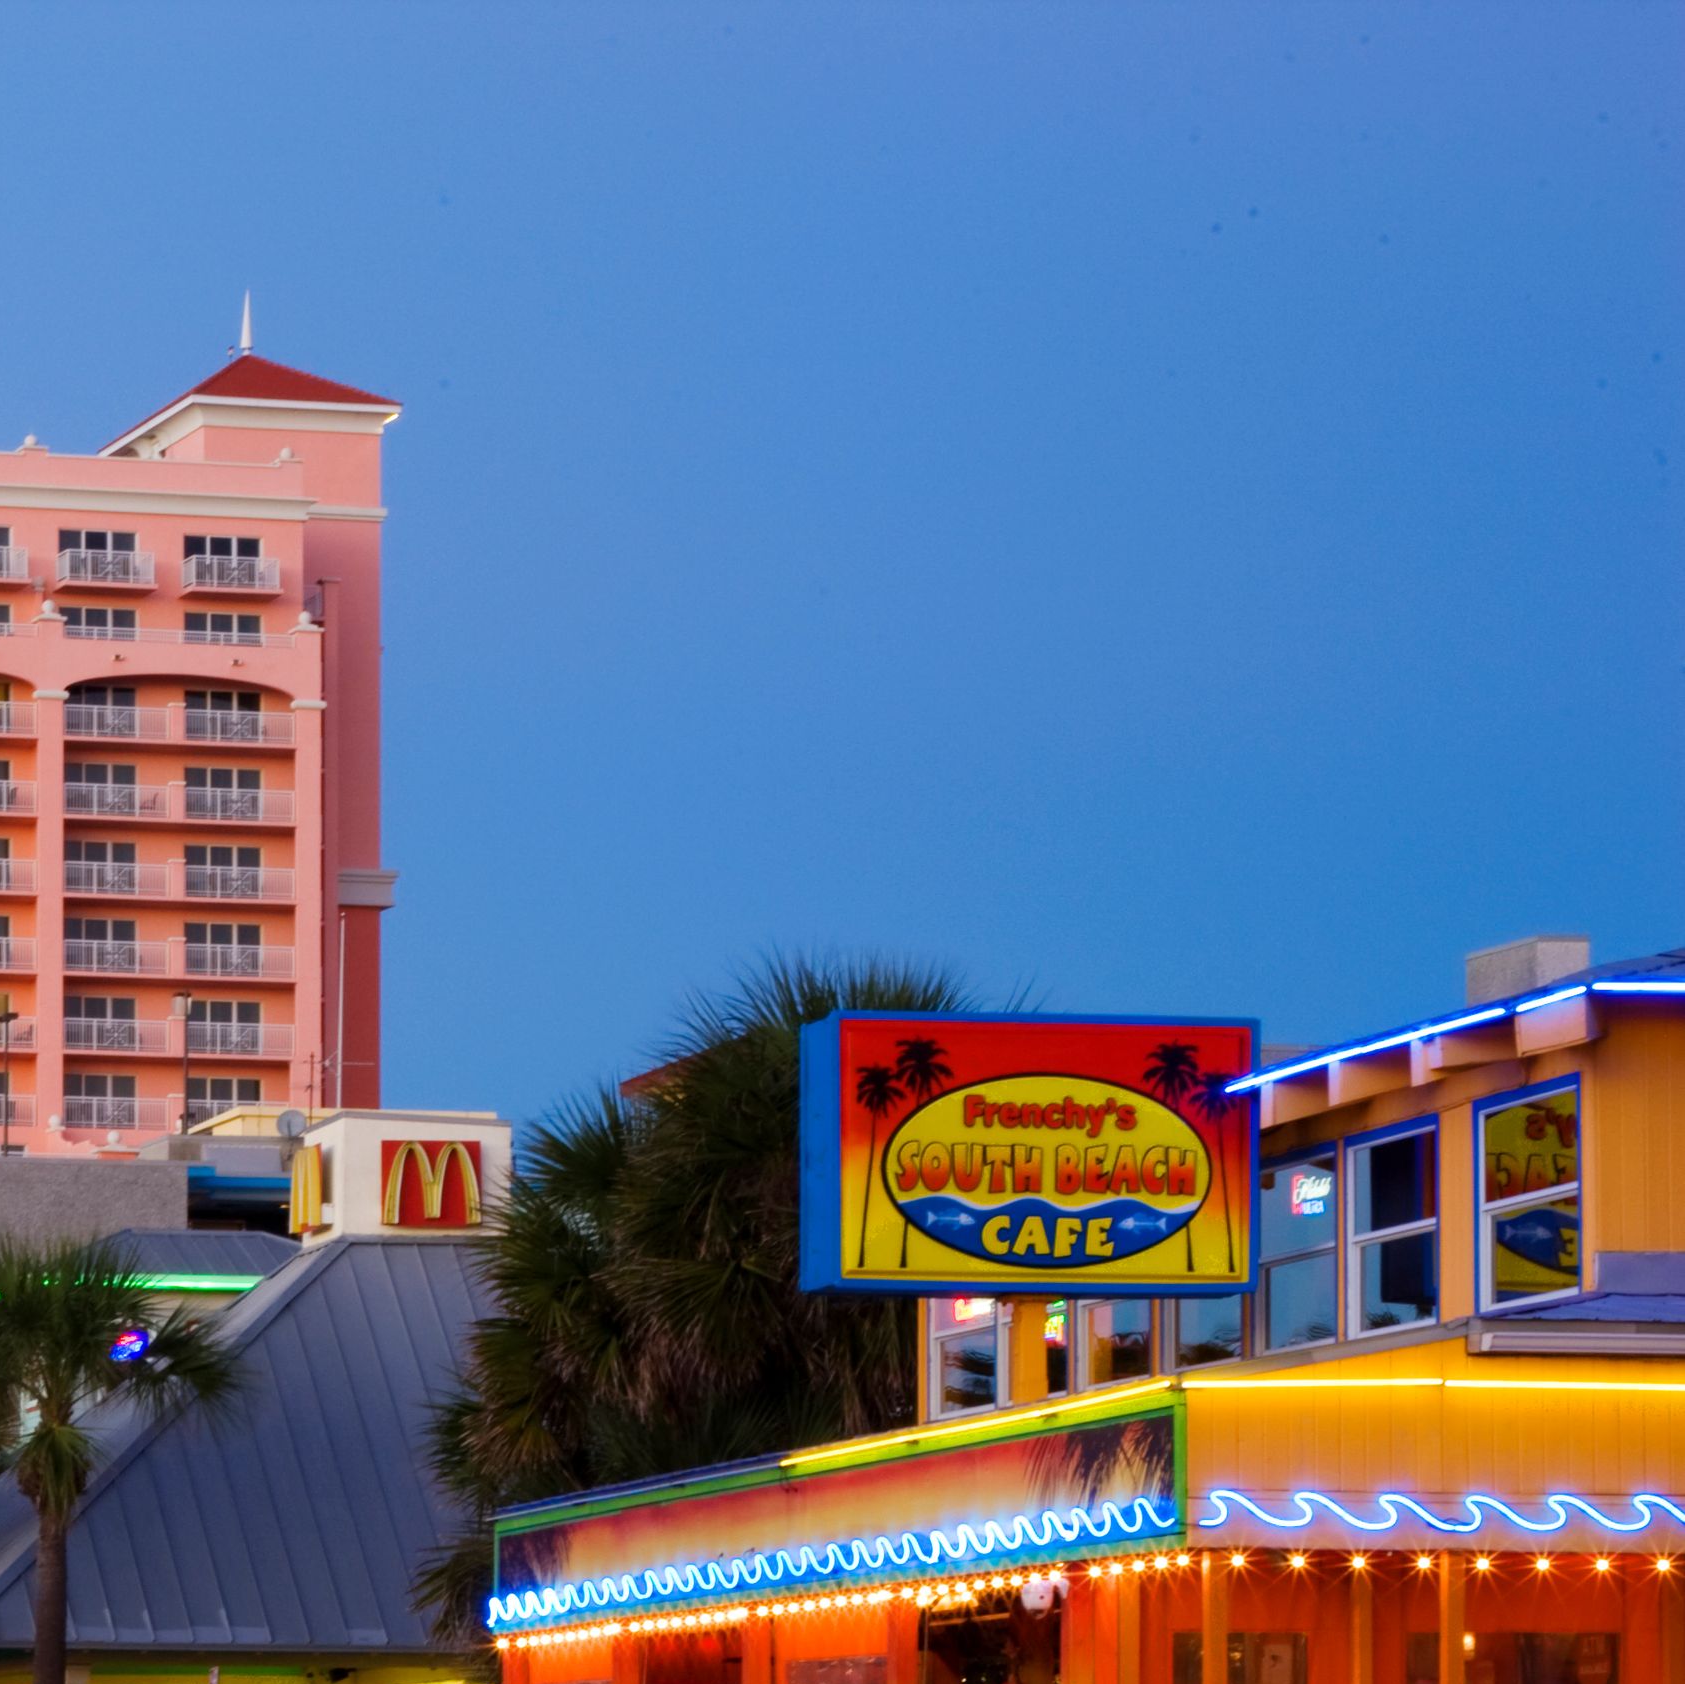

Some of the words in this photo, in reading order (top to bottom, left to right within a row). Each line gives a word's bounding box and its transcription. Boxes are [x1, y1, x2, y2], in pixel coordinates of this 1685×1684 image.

[962, 1094, 1138, 1138] Frenchy's
[894, 1140, 1043, 1195] SOUTH
[1054, 1142, 1198, 1197] BEACH
[980, 1213, 1116, 1260] CAFE
